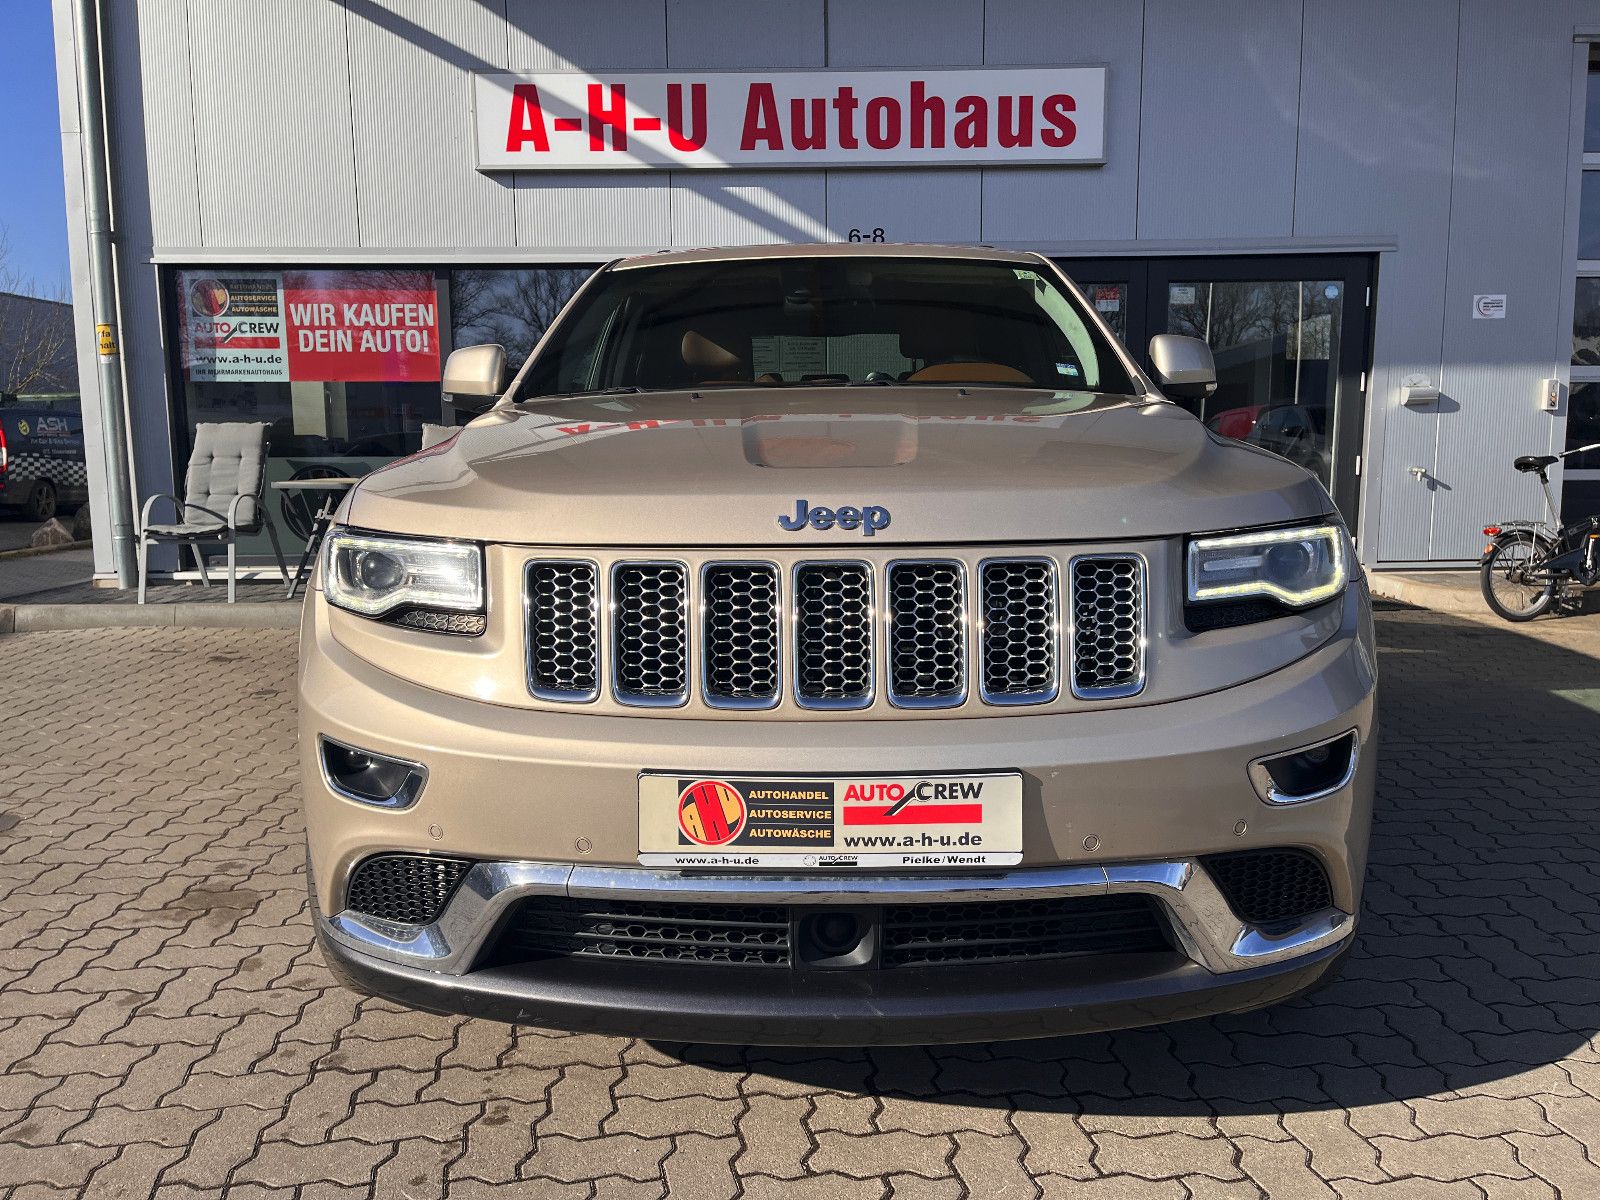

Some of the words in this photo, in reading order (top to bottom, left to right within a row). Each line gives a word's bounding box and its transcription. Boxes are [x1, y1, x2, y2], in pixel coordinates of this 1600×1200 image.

[506, 83, 707, 152] A-H-U
[740, 81, 1078, 151] Autohaus
[848, 228, 885, 243] 6-8
[289, 303, 336, 327] WIR
[343, 303, 434, 327] KAUFEN
[195, 322, 231, 333] AUTO
[238, 321, 279, 333] CREW
[298, 330, 353, 352] DEIN
[360, 330, 428, 352] AUTO!
[196, 354, 282, 364] www.a-h-u.de
[37, 417, 68, 432] ASH
[778, 500, 892, 536] Jeep
[749, 790, 829, 800] AUTOHANDEL
[844, 783, 905, 801] AUTO
[914, 781, 984, 801] CREW
[749, 809, 832, 819] AUTOSERVICE
[749, 827, 832, 839] AUTOWÄSCHE
[844, 832, 983, 847] www.a-h-u.de
[675, 856, 760, 865] www.a-h-u.de
